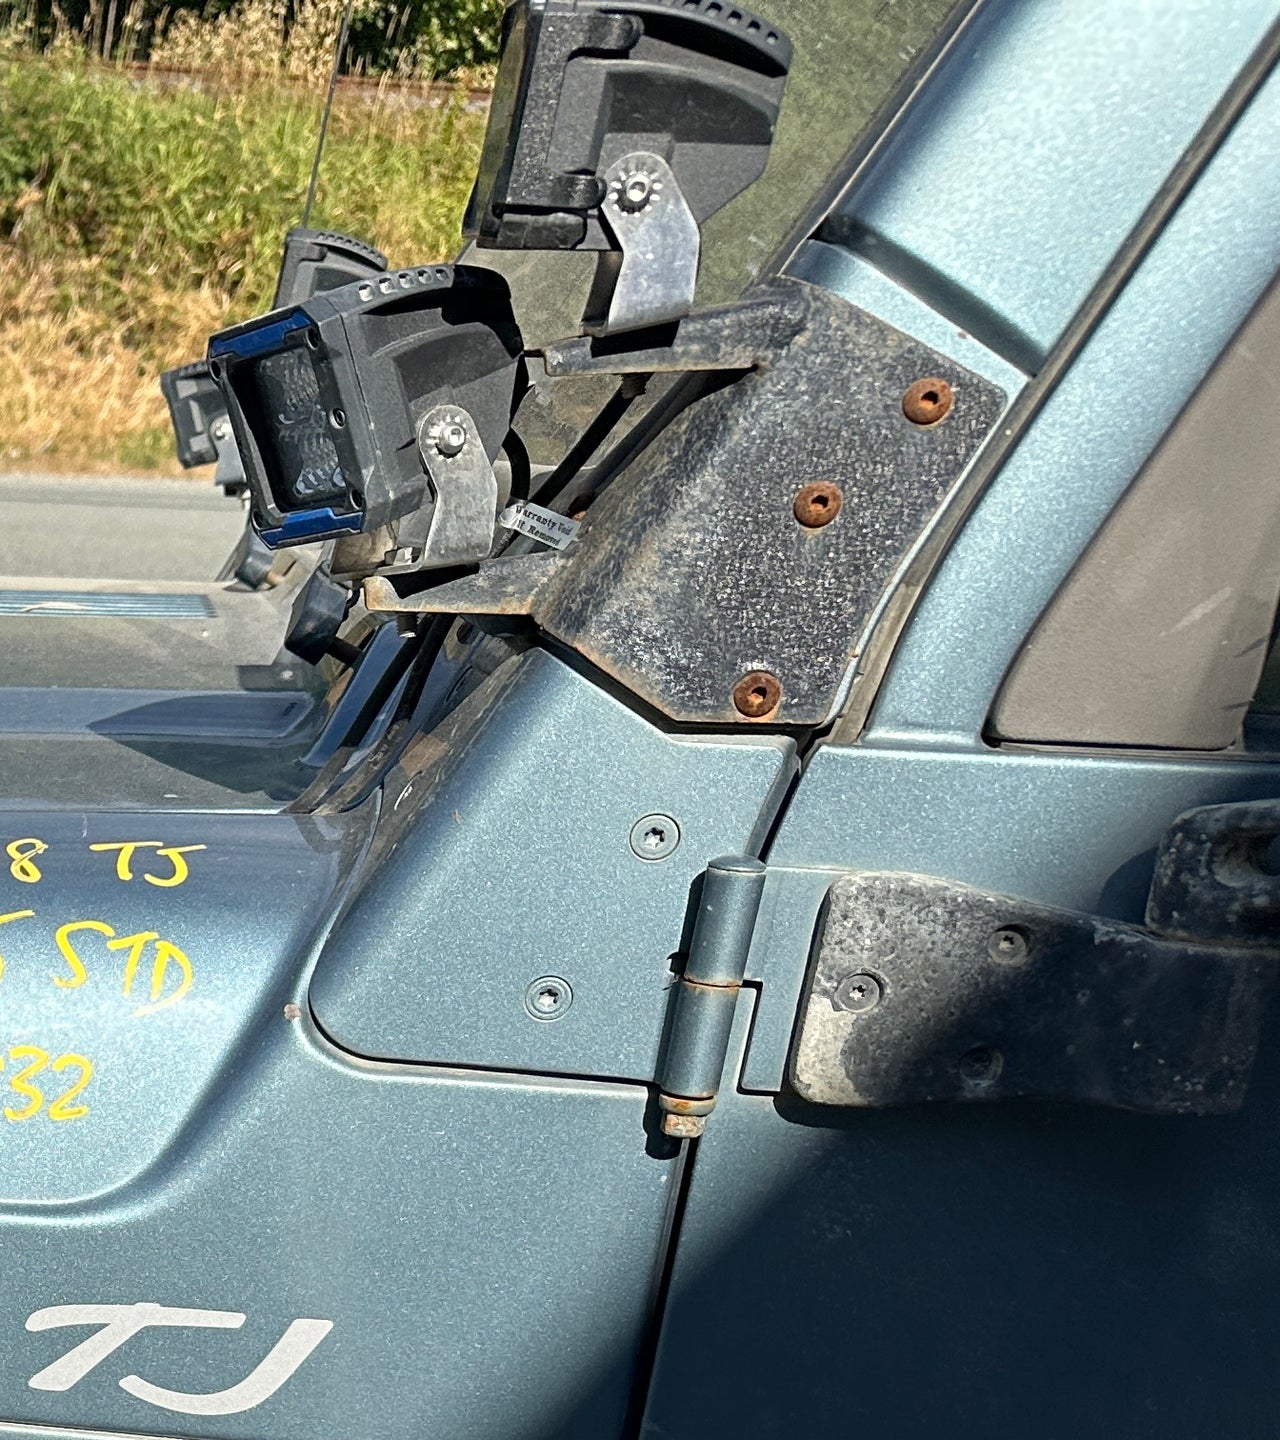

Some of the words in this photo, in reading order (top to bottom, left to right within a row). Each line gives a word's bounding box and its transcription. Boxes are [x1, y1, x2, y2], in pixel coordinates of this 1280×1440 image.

[89, 841, 207, 887] TJ
[52, 920, 193, 1017] STD
[25, 1302, 334, 1415] TJ
